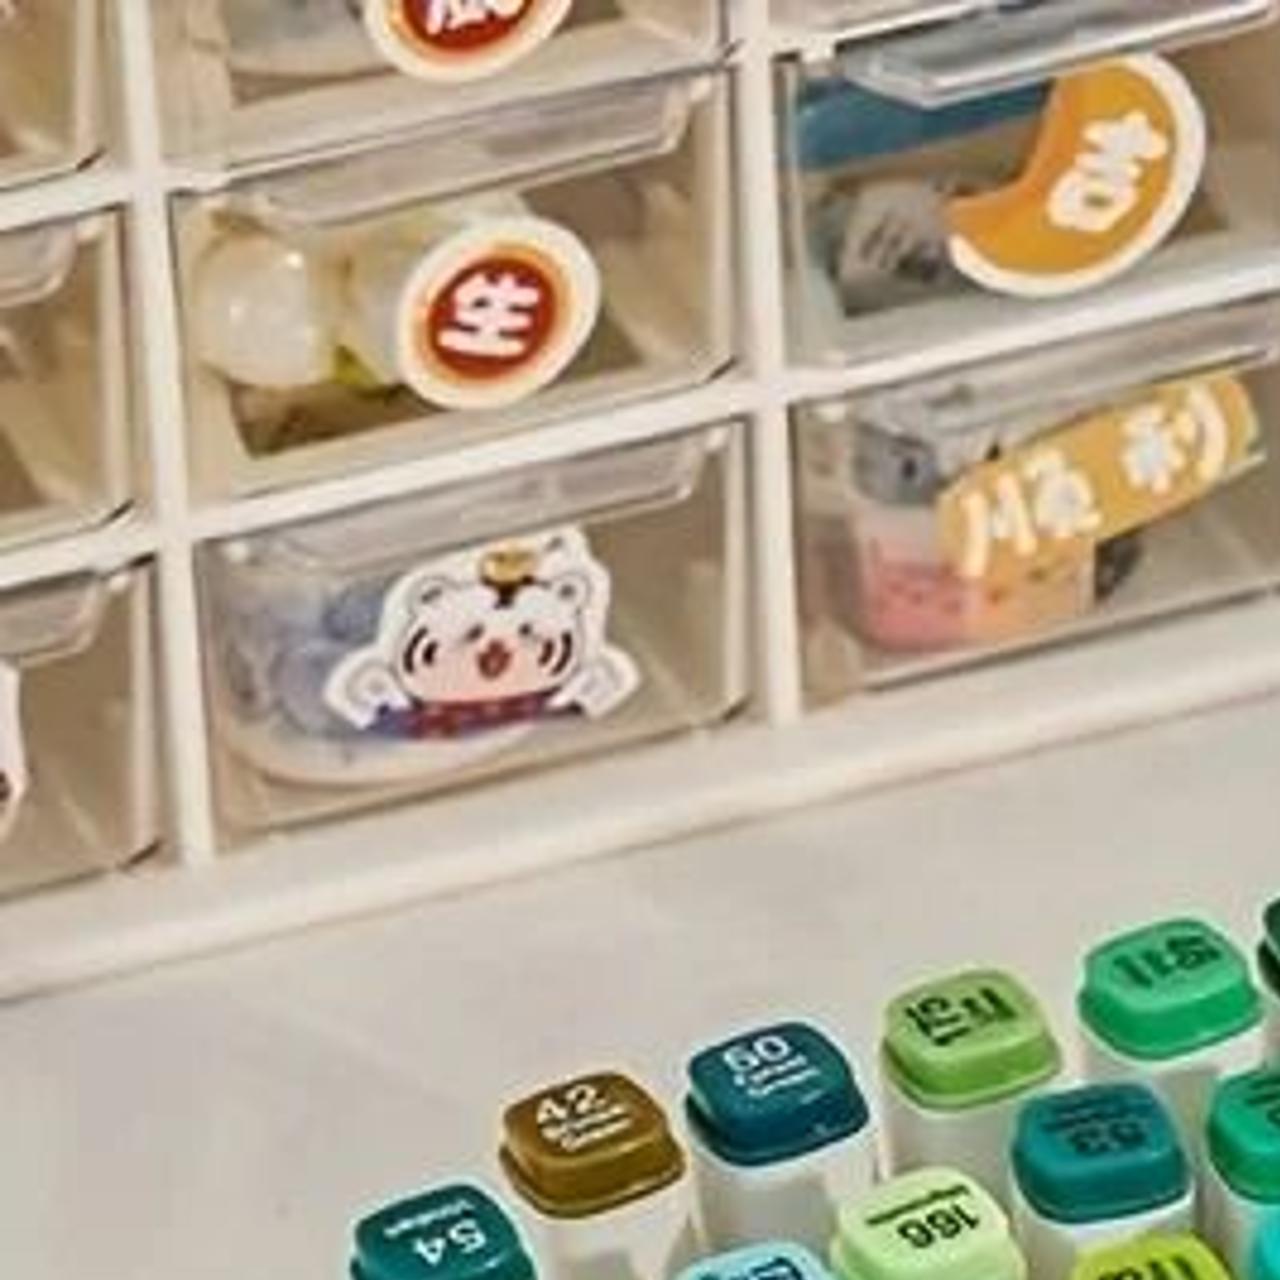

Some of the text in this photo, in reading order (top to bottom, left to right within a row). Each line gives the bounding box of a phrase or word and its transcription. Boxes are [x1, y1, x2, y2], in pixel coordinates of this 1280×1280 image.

[439, 272, 540, 356] 生
[535, 1083, 601, 1124] 42
[412, 1218, 487, 1265] 54
